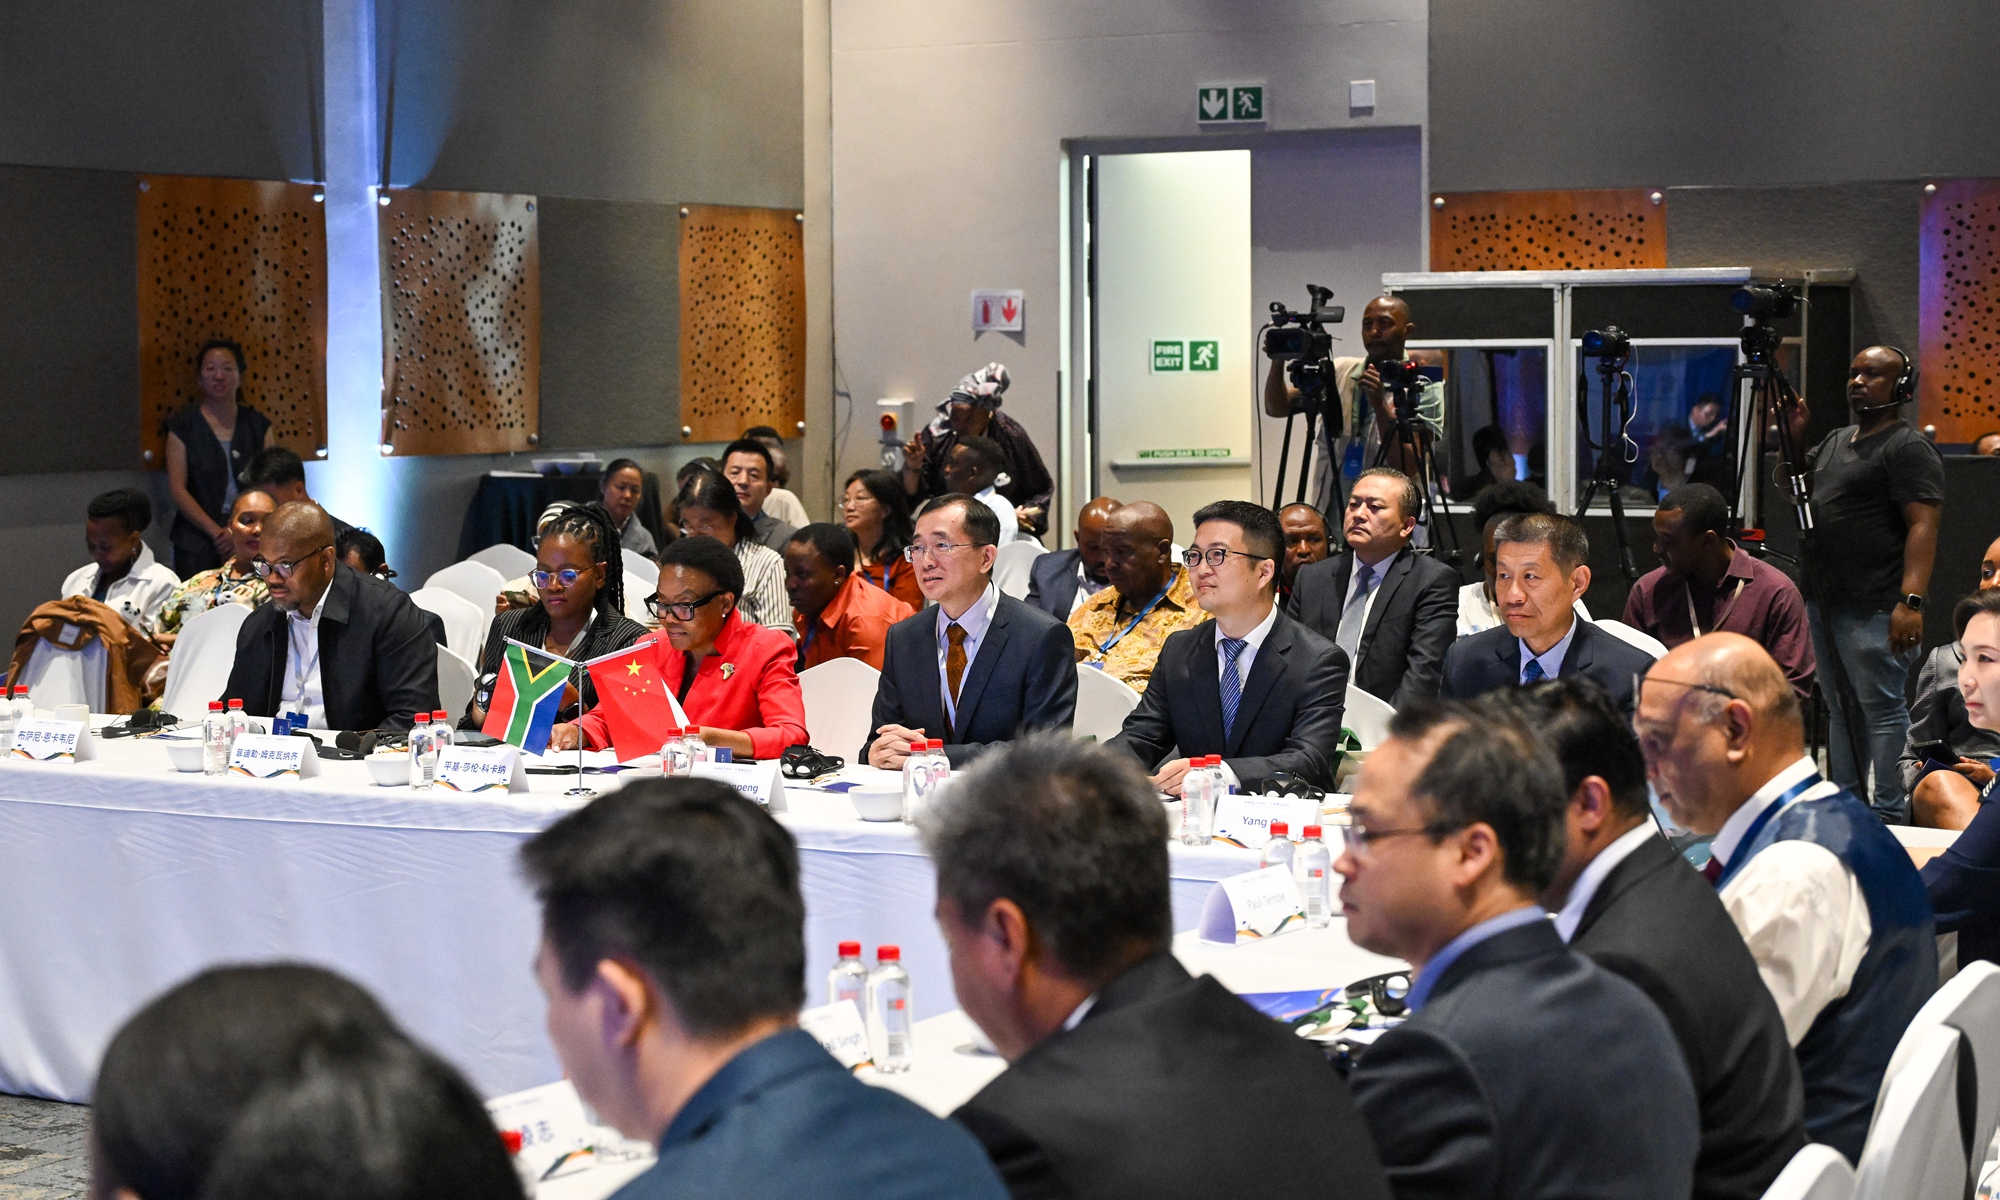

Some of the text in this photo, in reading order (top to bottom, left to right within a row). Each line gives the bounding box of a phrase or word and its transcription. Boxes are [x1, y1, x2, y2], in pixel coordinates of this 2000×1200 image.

[1156, 345, 1182, 355] FIRE
[1156, 357, 1182, 367] EXIT
[1152, 449, 1175, 458] PUSH
[1206, 448, 1229, 457] OPEN
[1242, 816, 1268, 829] Yang
[1246, 896, 1263, 910] Paul
